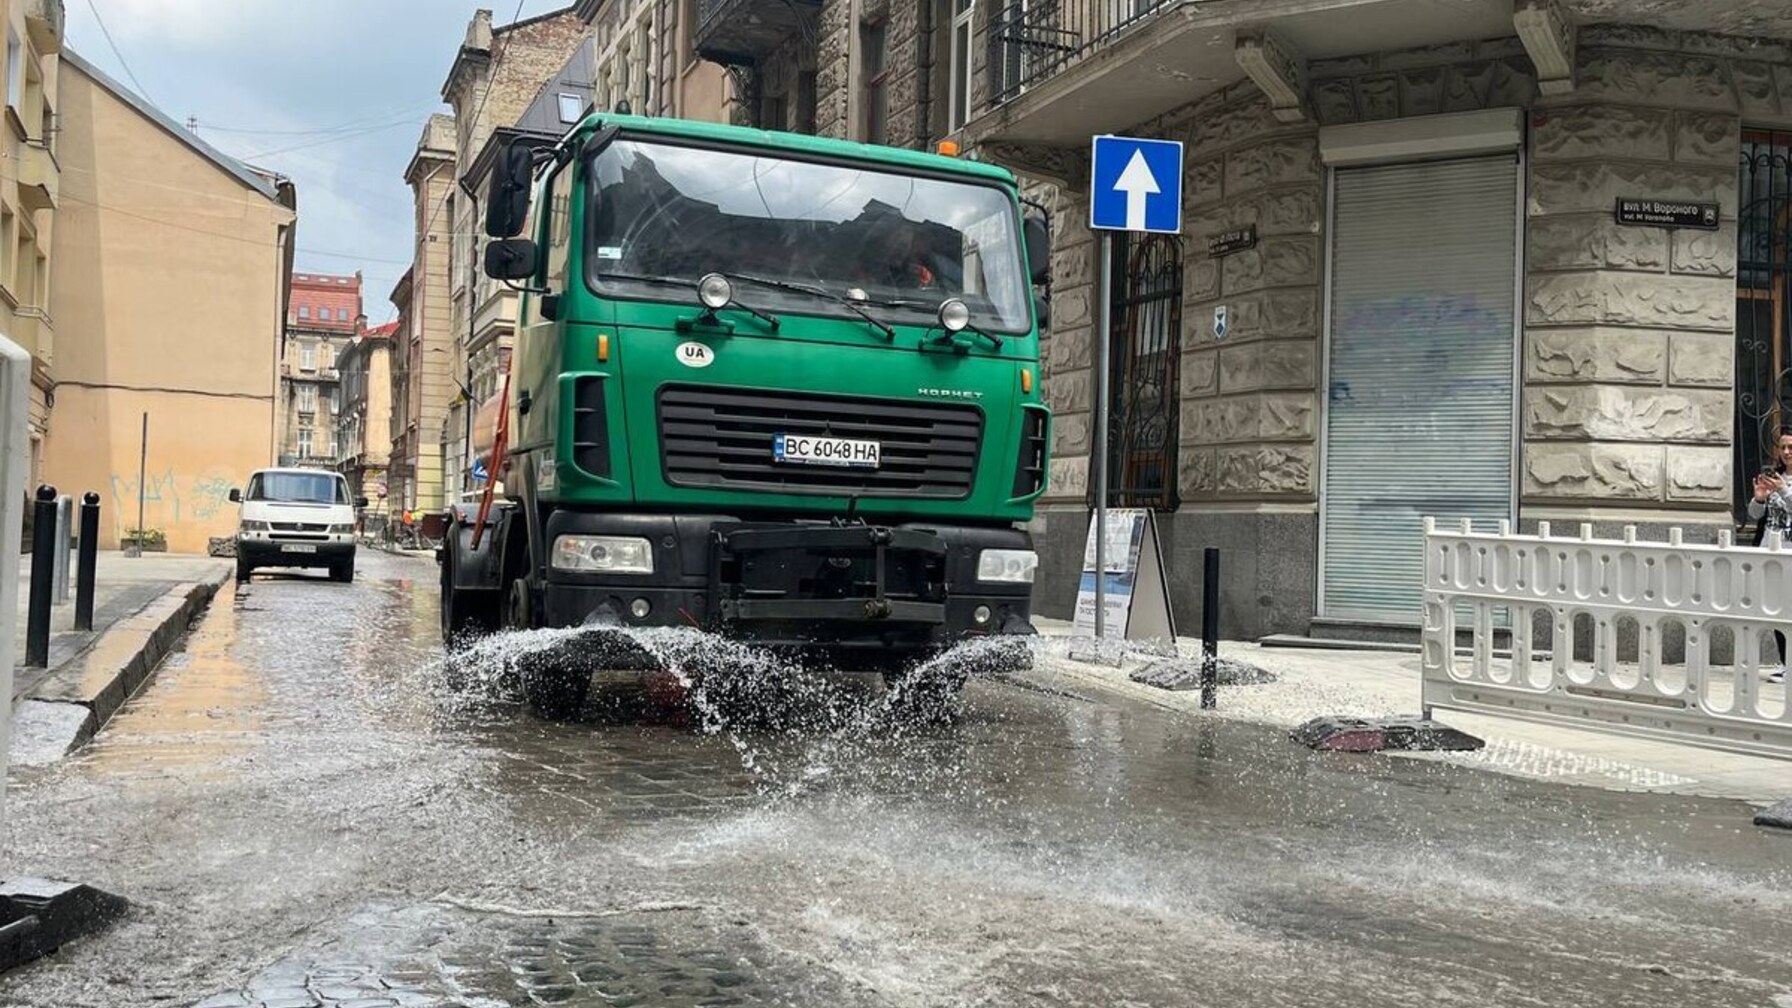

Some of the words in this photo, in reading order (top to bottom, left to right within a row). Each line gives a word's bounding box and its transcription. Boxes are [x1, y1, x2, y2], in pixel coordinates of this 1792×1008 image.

[1653, 203, 1699, 216] Вороного
[685, 346, 705, 359] UA
[785, 438, 810, 456] BC
[813, 440, 851, 459] 6048
[853, 443, 877, 461] HA
